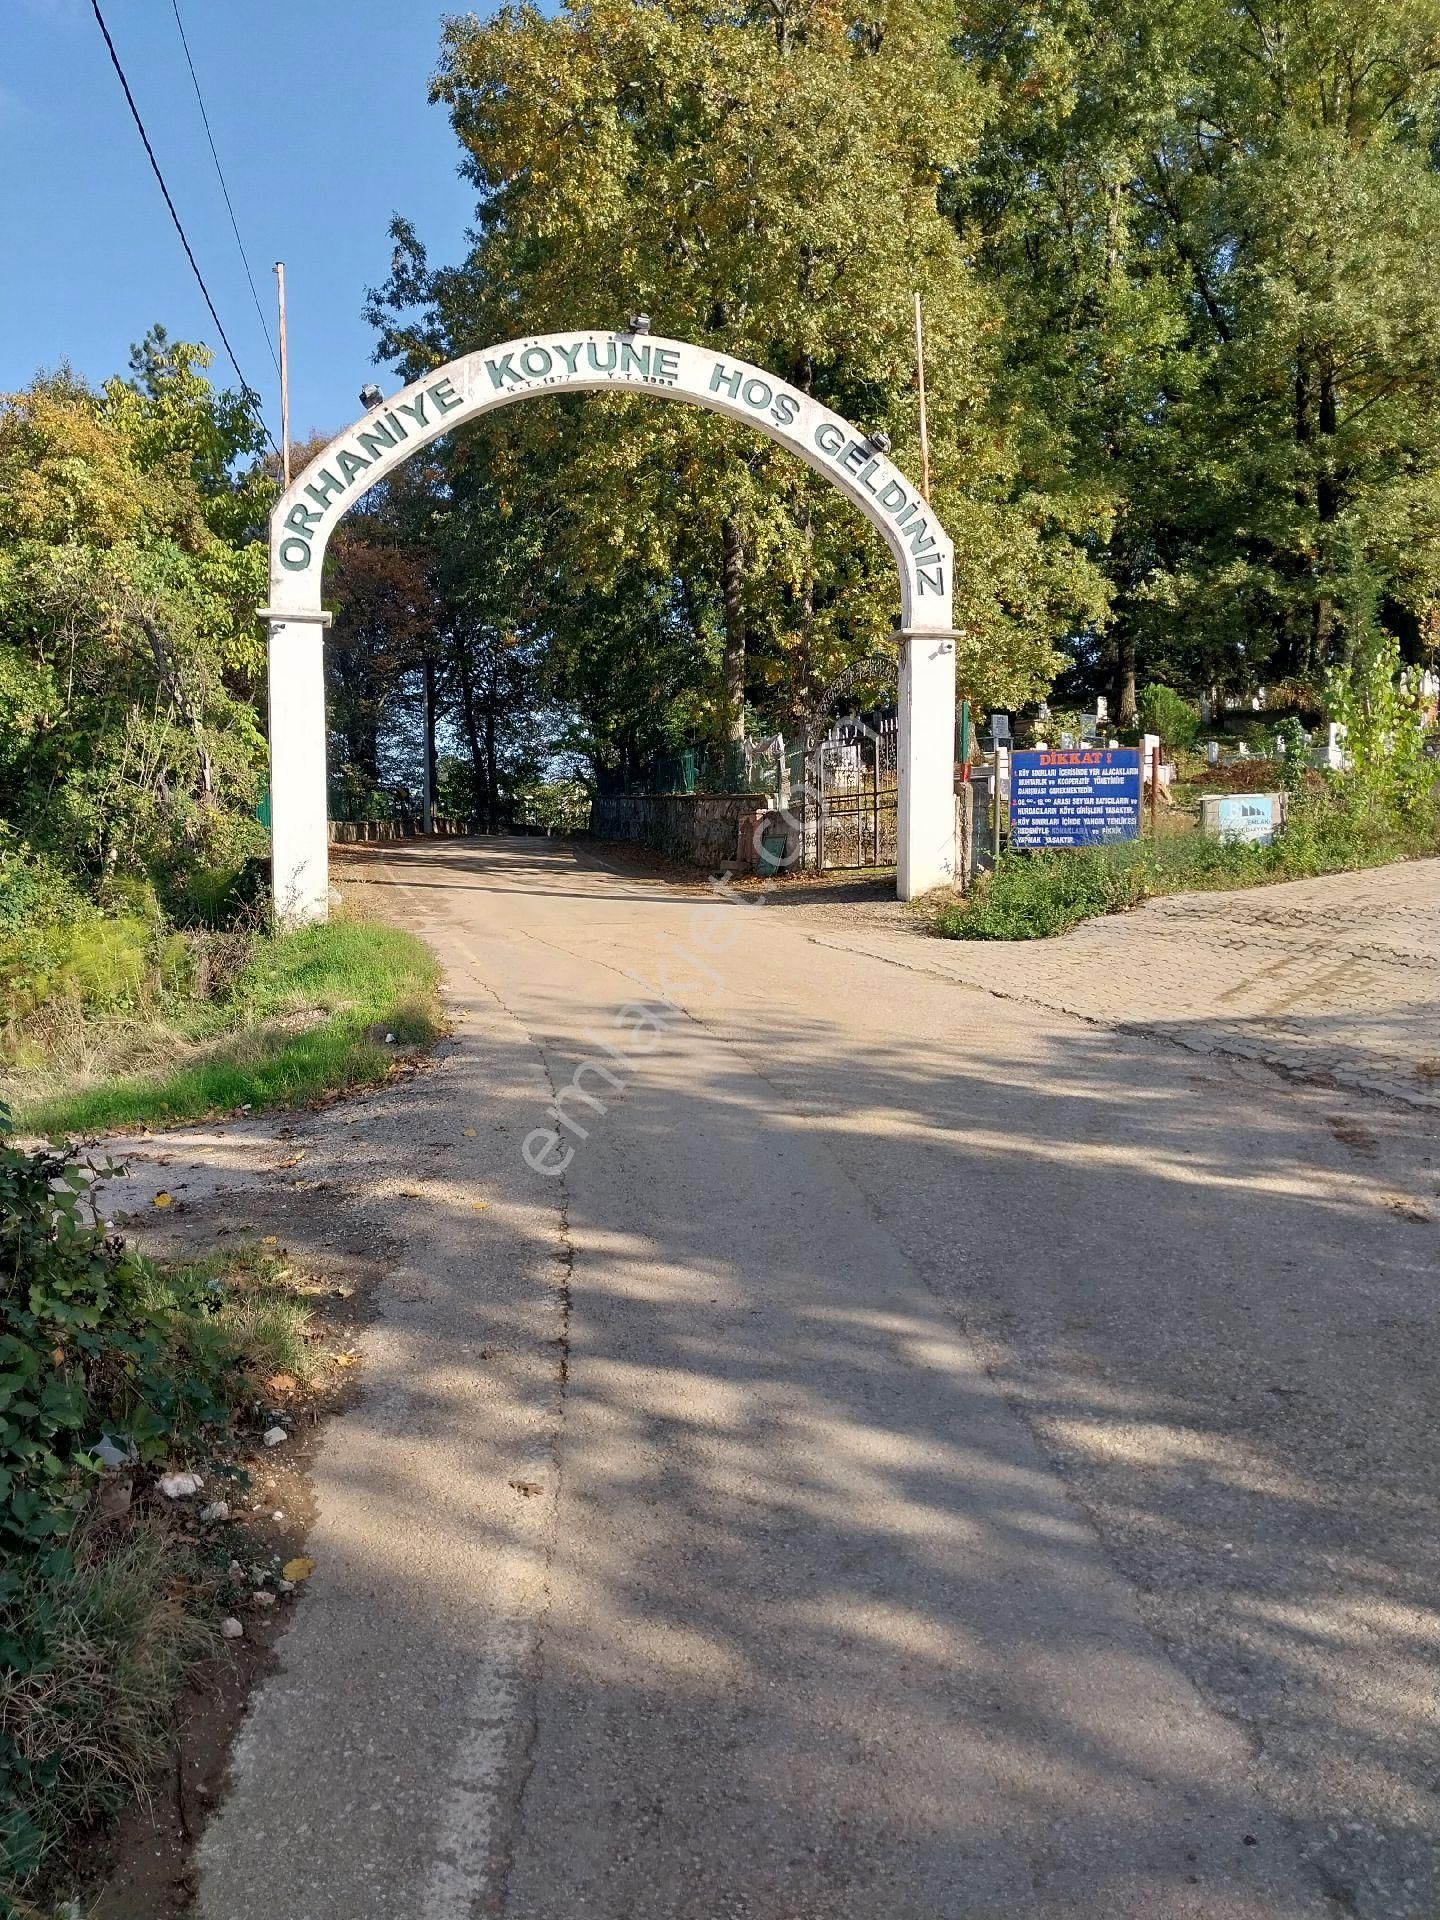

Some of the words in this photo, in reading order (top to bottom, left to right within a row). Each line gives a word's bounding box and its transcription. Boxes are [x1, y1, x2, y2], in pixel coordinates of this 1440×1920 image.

[279, 377, 464, 572] ORHANİYE
[484, 335, 681, 390] KÖYÜNE
[708, 363, 801, 428] HOŞ
[813, 423, 946, 597] GELDİNİZ
[1040, 752, 1103, 766] DİKKAT
[1018, 769, 1029, 777] KÖY
[1032, 768, 1057, 777] SINIRLARI
[1059, 767, 1088, 777] İÇERİSİNDE
[1089, 768, 1100, 776] YER
[1102, 767, 1139, 776] ALACAKLARIN
[1018, 778, 1047, 786] MUHTARLIK
[1057, 777, 1090, 785] KOOPERATİF
[1094, 776, 1125, 785] YÖNETİMİNE
[1018, 787, 1047, 795] DANIŞMASI
[1049, 786, 1095, 794] GEREKMEKTEDİR.
[1053, 798, 1071, 806] ARASI
[1072, 797, 1094, 805] SEYYAR
[1095, 797, 1129, 805] SATICILARIN
[1018, 807, 1057, 815] HURDACILARIN
[1059, 806, 1075, 815] KÖYE
[1076, 805, 1103, 815] GİRİŞLERİ
[1018, 817, 1029, 825] KÖY
[1032, 818, 1060, 826] SINIRLARI
[1062, 817, 1081, 826] İÇİNDE
[1107, 817, 1137, 825] TEHLİKESİ
[1018, 826, 1050, 835] NEDENİYLE
[1101, 826, 1121, 835] PİKNİK
[1018, 836, 1042, 844] YAPMAK
